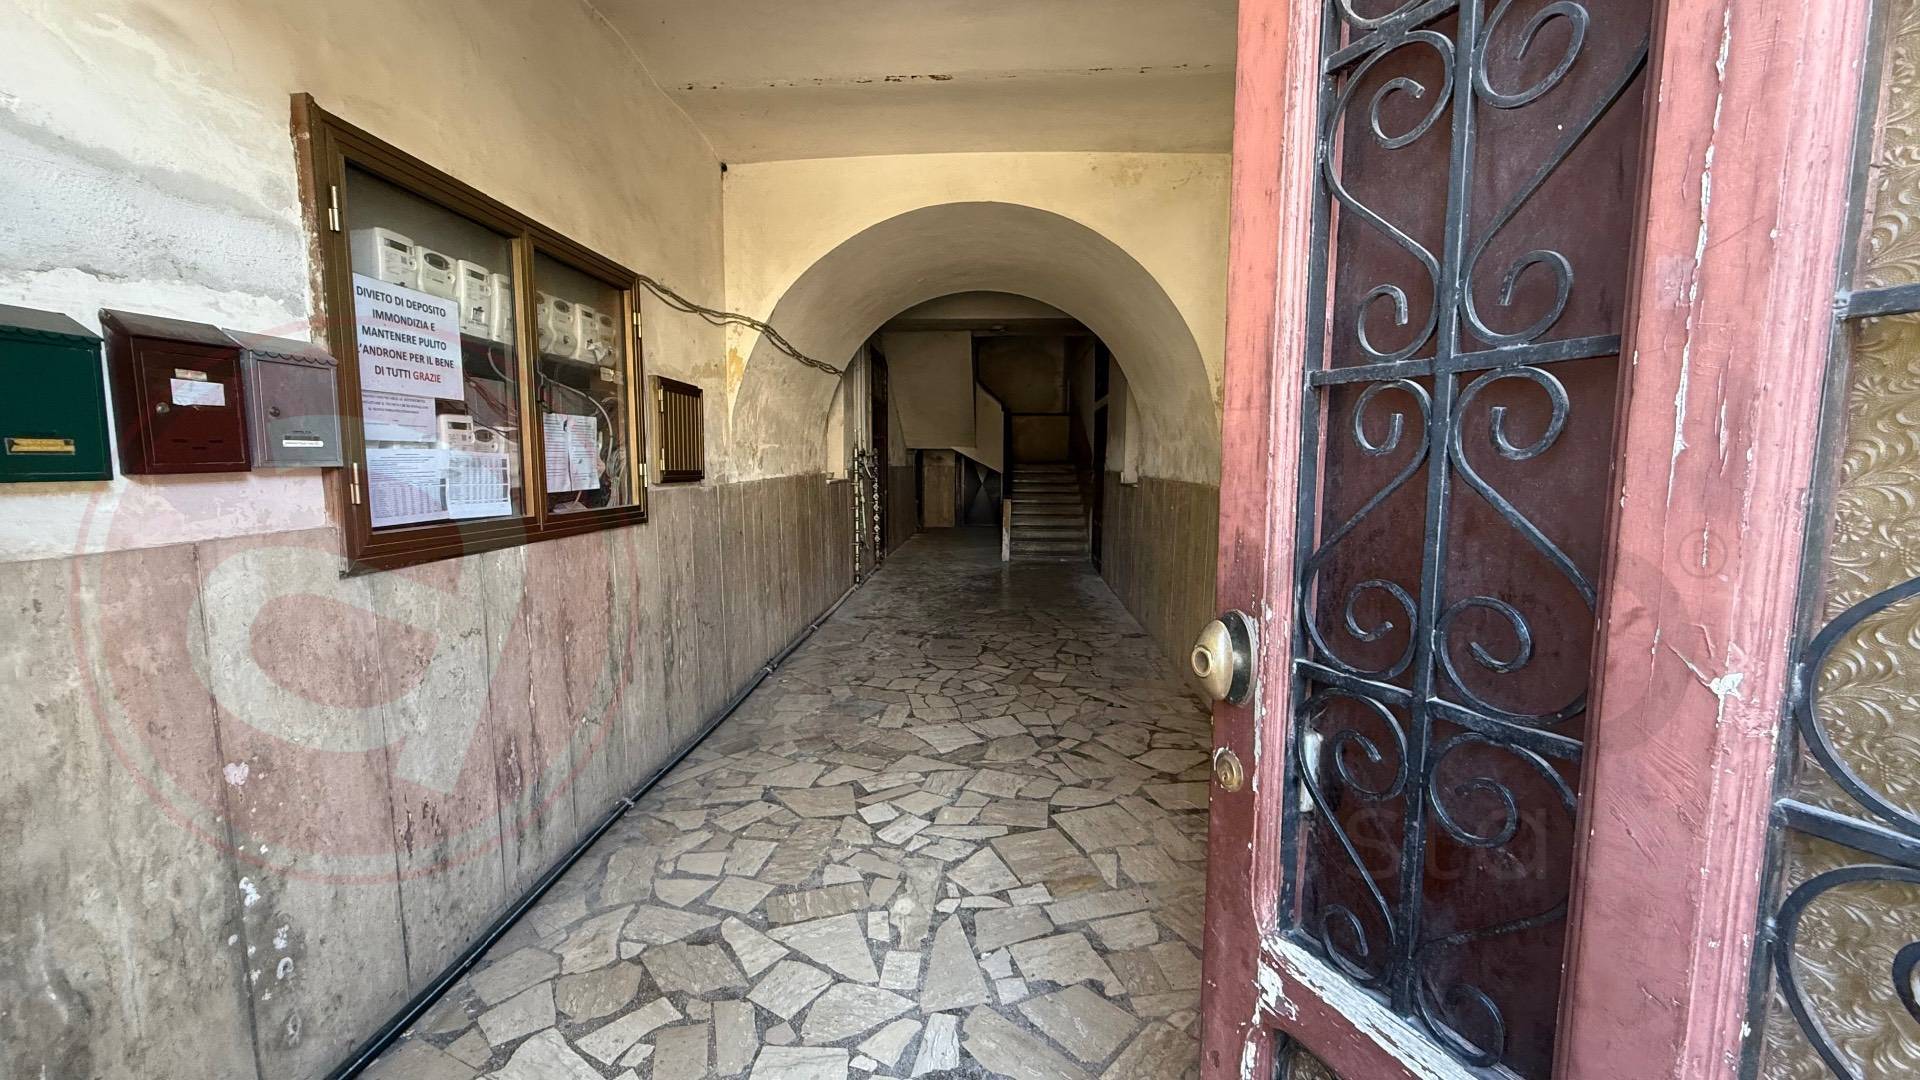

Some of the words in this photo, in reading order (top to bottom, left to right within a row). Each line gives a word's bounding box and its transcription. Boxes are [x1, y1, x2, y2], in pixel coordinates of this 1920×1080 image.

[356, 285, 393, 304] DIVIETO
[394, 296, 404, 307] DI
[406, 299, 446, 317] DEPOSITO
[372, 309, 429, 330] IMMONDIZIA
[430, 322, 436, 332] E
[361, 325, 417, 345] MANTENERE
[418, 336, 447, 350] PULITO
[358, 343, 407, 361] 'ANDRONE
[409, 352, 425, 364] PER
[426, 355, 434, 366] IL
[435, 357, 455, 368] BENE
[374, 365, 385, 376] DI
[386, 366, 411, 379] TUTTI
[412, 371, 442, 383] GRAZIE
